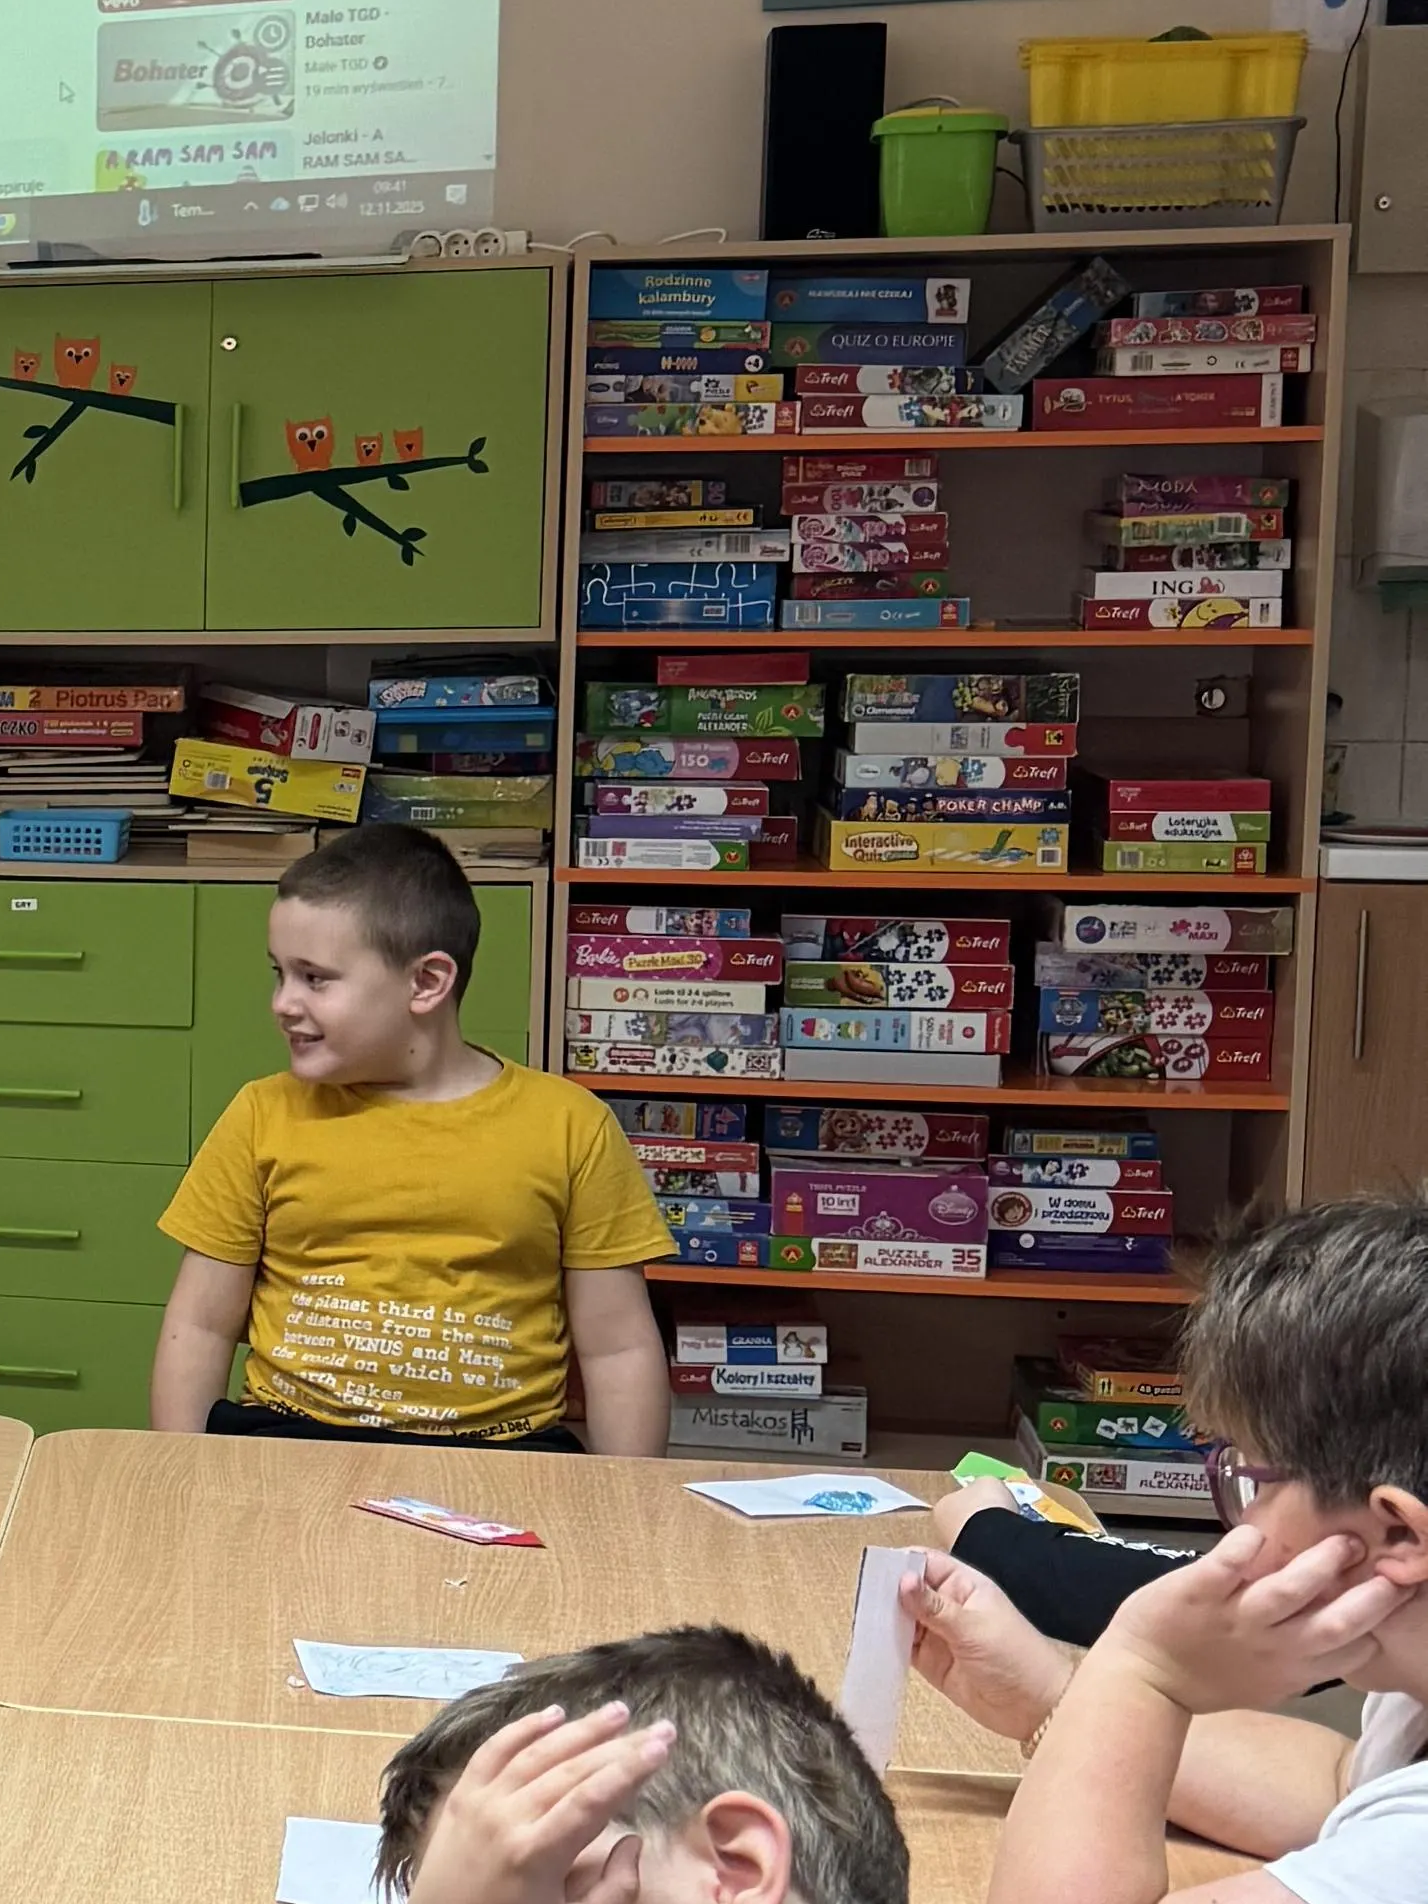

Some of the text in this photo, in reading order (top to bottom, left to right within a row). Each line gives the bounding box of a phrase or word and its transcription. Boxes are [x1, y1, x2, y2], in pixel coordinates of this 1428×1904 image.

[348, 7, 380, 22] TGD
[305, 32, 366, 49] Bohater
[112, 57, 208, 84] Bohater
[303, 128, 359, 146] Jelonki
[105, 140, 278, 169] A RAM SAM SAM
[303, 152, 380, 170] RAM SAM
[645, 274, 712, 288] Rodzinne
[638, 290, 716, 307] kalambury
[831, 334, 956, 348] QUIZ O EUROPIE
[820, 372, 848, 386] Trefl
[826, 405, 855, 419] Trefl
[1152, 579, 1194, 595] ING
[1110, 607, 1140, 620] Trefl
[55, 687, 173, 709] Piotruś Pan
[697, 721, 749, 732] ALEXANDER
[680, 754, 710, 768] 150
[761, 752, 790, 764] Trefl
[1029, 766, 1059, 779] Trefl
[937, 798, 1043, 813] POKER CHAMP
[1168, 817, 1218, 829] Loteryjka
[761, 832, 790, 844] Trefl
[1164, 827, 1223, 839] edukacyjna
[845, 833, 914, 849] Interactive
[853, 848, 883, 863] Quiz
[591, 912, 619, 925] Trefl
[971, 936, 1001, 950] Trefl
[575, 944, 621, 967] Barbie
[745, 953, 775, 967] Trefl
[1231, 961, 1260, 974] Trefl
[976, 981, 1006, 994] Trefl
[677, 998, 689, 1006] for
[704, 999, 734, 1008] players
[1236, 1007, 1265, 1020] Trefl
[1233, 1051, 1262, 1065] Trefl
[951, 1130, 980, 1145] Trefl
[820, 1196, 835, 1208] 10
[934, 1197, 976, 1218] Disney
[1048, 1197, 1096, 1209] W domu
[1136, 1207, 1166, 1220] Trefl
[876, 1248, 931, 1260] PUZZLE
[951, 1248, 982, 1266] 35
[863, 1256, 943, 1270] ALEXANDER
[314, 1294, 370, 1314] planet
[378, 1300, 436, 1321] third
[443, 1307, 466, 1325] in
[286, 1311, 475, 1345] of distance from the
[343, 1333, 404, 1357] VENUS
[411, 1344, 451, 1363] and
[732, 1336, 773, 1346] GRANNA
[354, 1358, 378, 1373] on
[388, 1360, 453, 1385] which
[462, 1370, 487, 1387] we
[716, 1368, 815, 1387] Kolory kształty
[692, 1407, 789, 1431] Mistakos
[1153, 1470, 1206, 1481] PUZZLE
